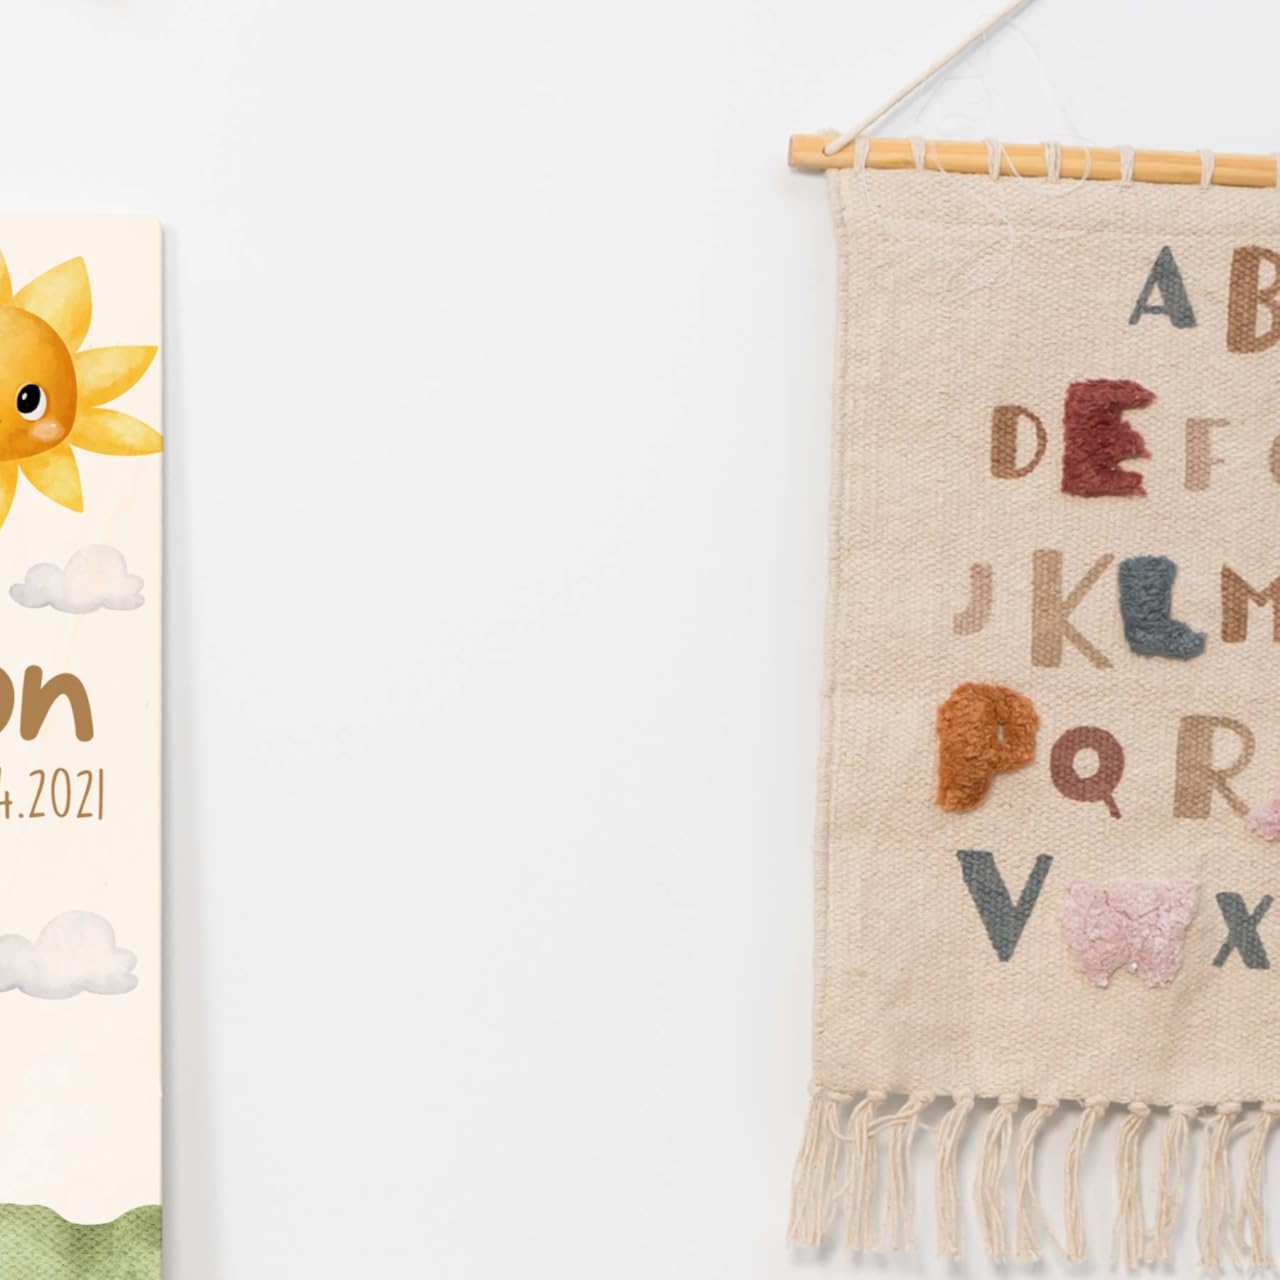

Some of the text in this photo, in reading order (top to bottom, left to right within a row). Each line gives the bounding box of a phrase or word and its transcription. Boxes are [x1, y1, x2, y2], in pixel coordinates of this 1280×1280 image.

[1129, 245, 1198, 329] A
[990, 404, 1048, 480] D
[1061, 378, 1157, 498] E
[1183, 417, 1231, 493] F
[952, 562, 993, 636] J
[1031, 548, 1116, 670] K
[1118, 554, 1207, 661] L
[935, 682, 1041, 813] P
[1050, 725, 1125, 819] Q
[1172, 714, 1256, 820] R
[956, 849, 1054, 963] V
[1211, 890, 1275, 970] X
